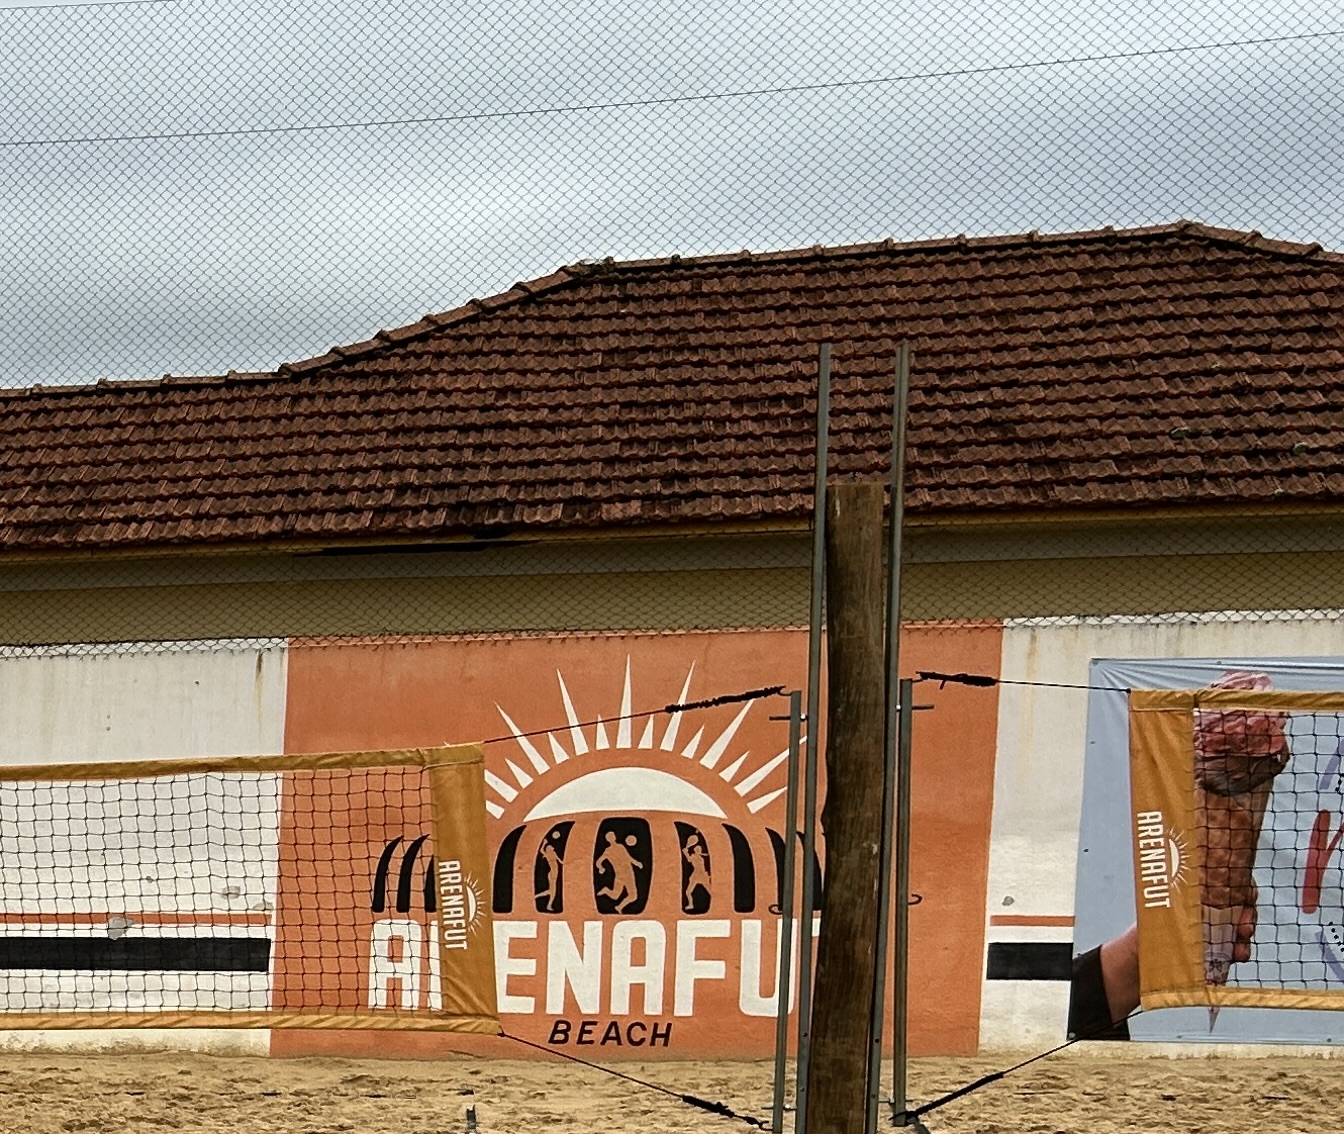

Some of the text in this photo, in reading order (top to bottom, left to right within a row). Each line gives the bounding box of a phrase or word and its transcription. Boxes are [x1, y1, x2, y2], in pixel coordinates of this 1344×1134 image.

[438, 860, 468, 950] ARENAFUT
[1137, 811, 1172, 909] ARENAFUT
[367, 918, 821, 1018] AENAFU
[548, 1020, 672, 1047] BEACH
